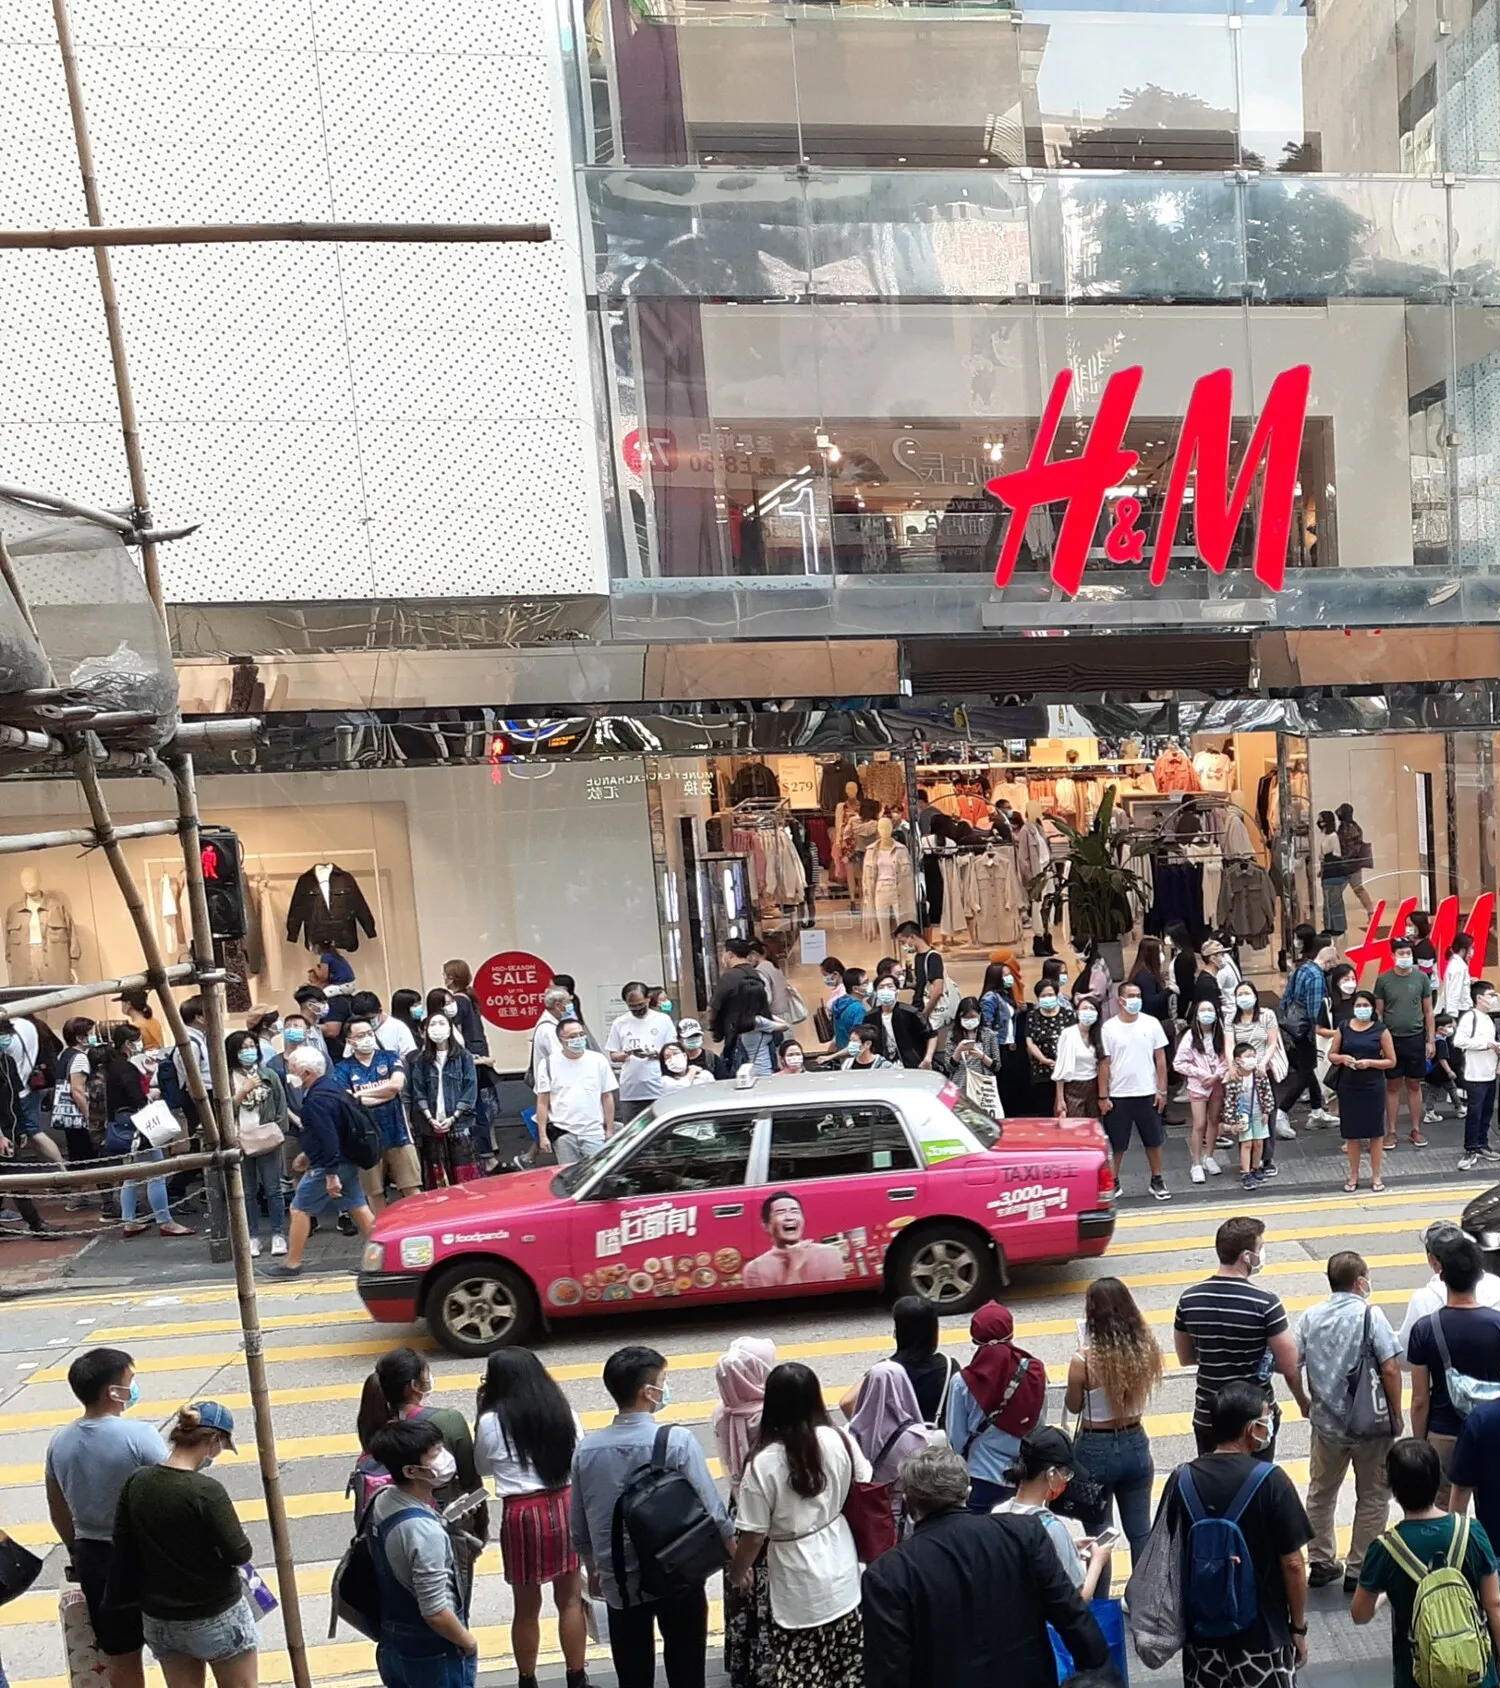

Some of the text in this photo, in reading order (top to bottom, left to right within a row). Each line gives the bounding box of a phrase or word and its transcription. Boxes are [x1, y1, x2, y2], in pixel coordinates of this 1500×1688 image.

[985, 364, 1312, 597] H&M
[492, 971, 537, 985] SALE
[486, 993, 546, 1006] 60% OFF
[1001, 1166, 1040, 1183] TAXI
[455, 1230, 510, 1243] foodpanda
